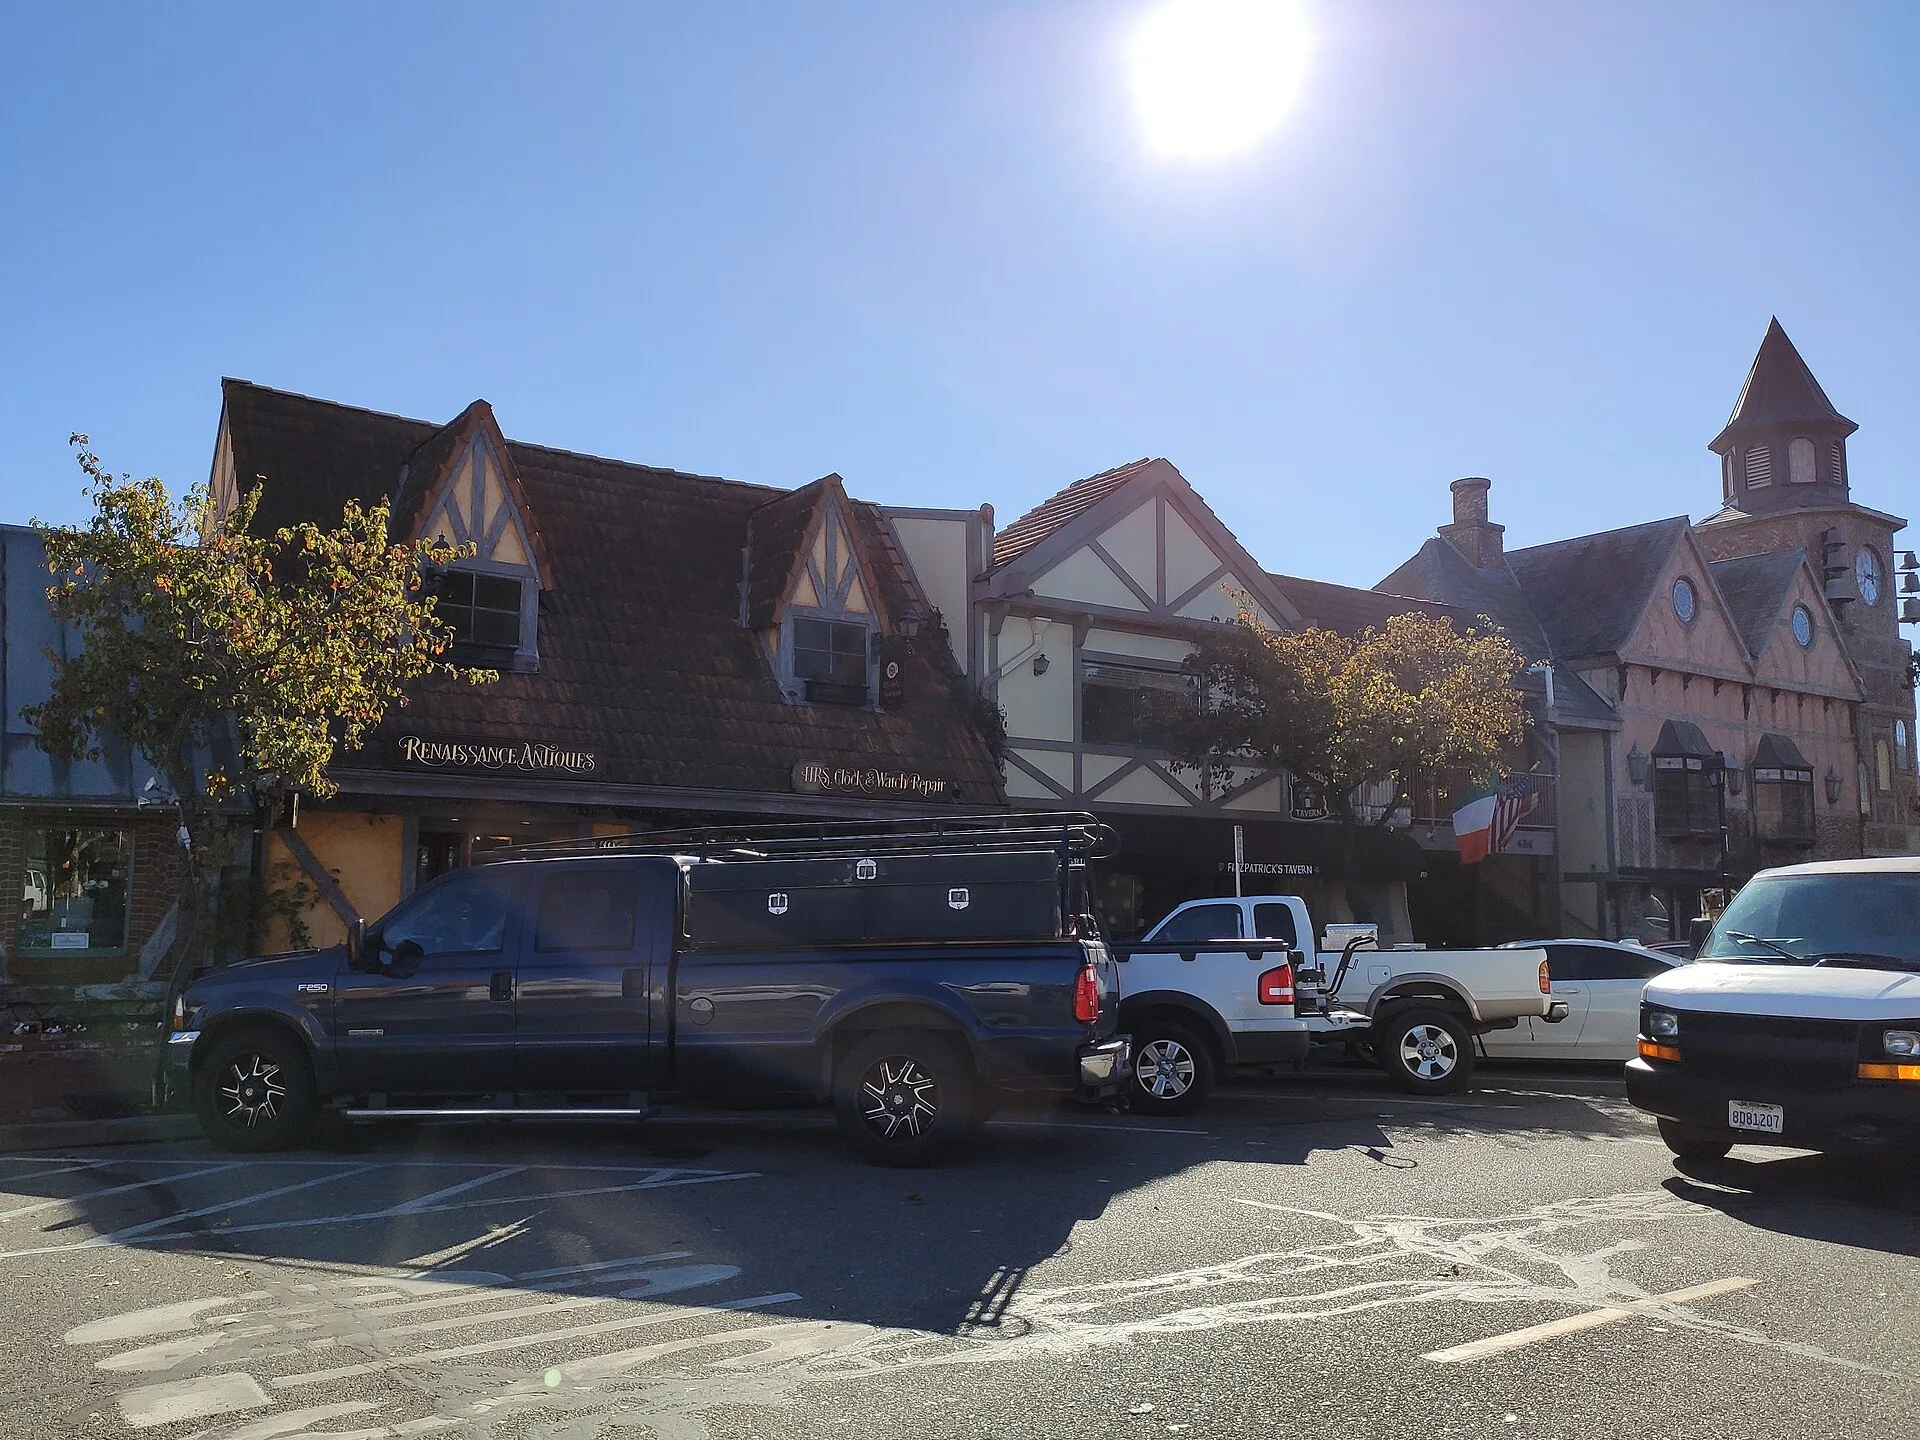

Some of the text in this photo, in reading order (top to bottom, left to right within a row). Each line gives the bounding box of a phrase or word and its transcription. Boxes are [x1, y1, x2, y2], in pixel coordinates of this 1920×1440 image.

[398, 735, 596, 773] RENAISSANCE ANTIQUES
[834, 768, 870, 793] Clock
[877, 769, 907, 795] Watch
[907, 773, 947, 798] Repair
[1295, 808, 1322, 817] TAVERN
[1227, 862, 1313, 875] FIZPATRICK'S TAVERN
[297, 983, 328, 992] F250
[1732, 1111, 1780, 1128] 8D81207
